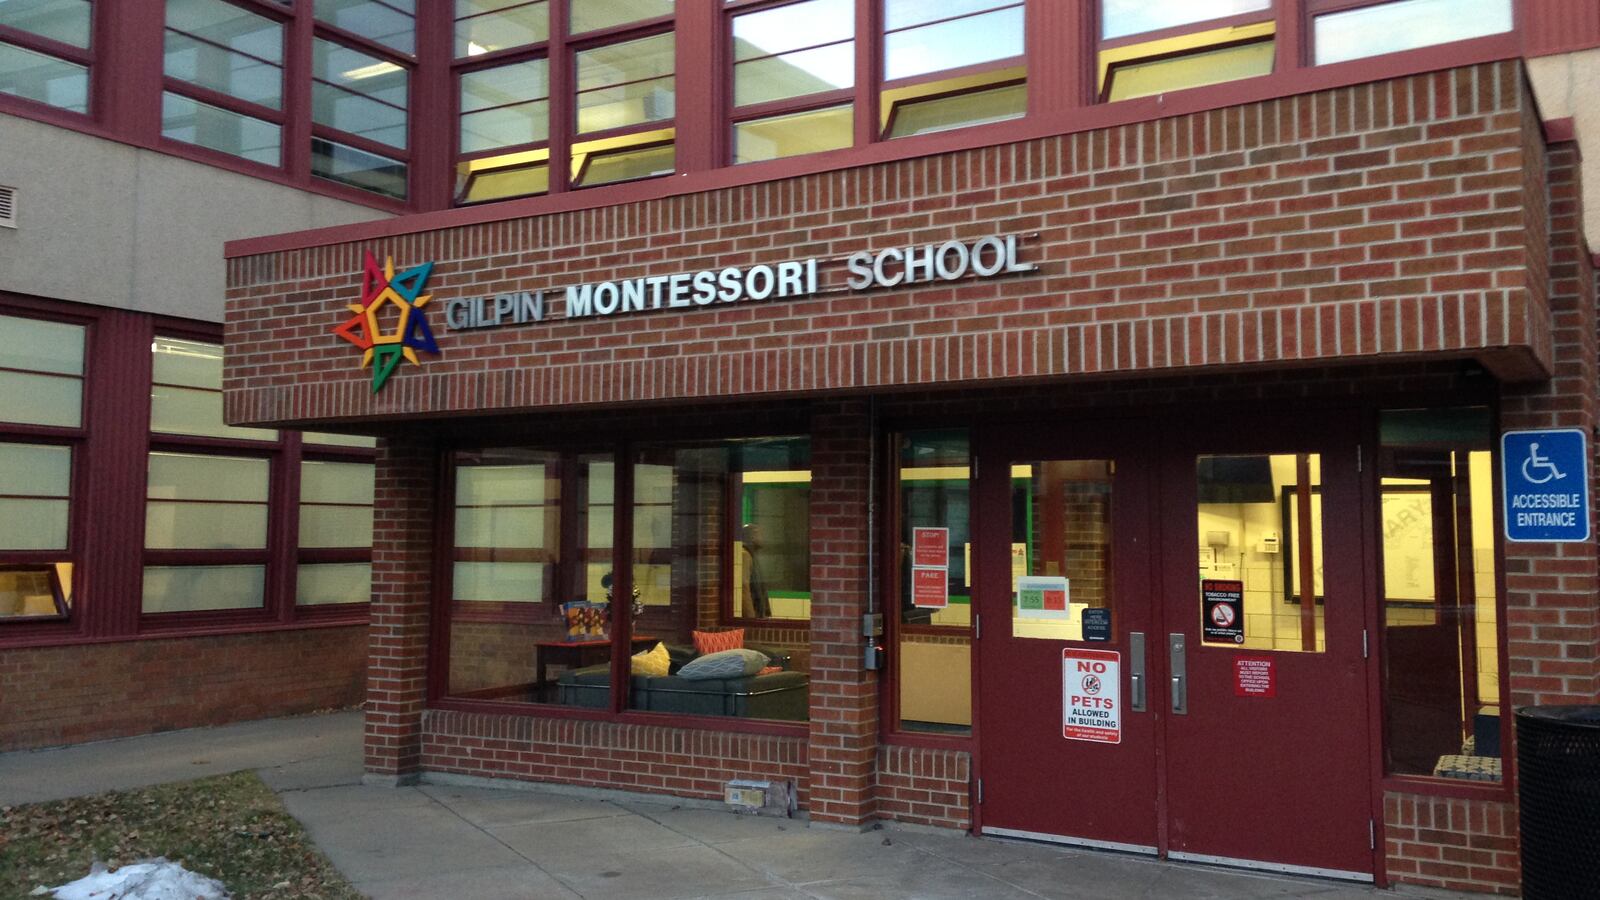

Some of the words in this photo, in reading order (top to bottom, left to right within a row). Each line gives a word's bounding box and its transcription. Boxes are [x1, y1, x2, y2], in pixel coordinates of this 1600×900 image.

[446, 289, 544, 329] GILPIN
[565, 258, 817, 318] MONTESSORI
[847, 235, 1034, 290] SCHOOL
[1512, 494, 1581, 508] ACCESSIBLE
[1517, 512, 1576, 527] ENTRANCE
[1077, 661, 1106, 673] NO
[1071, 695, 1114, 709] PETS
[1072, 708, 1109, 718] ALLOWED
[1068, 716, 1076, 724] IN
[1078, 717, 1116, 728] BUILDING
